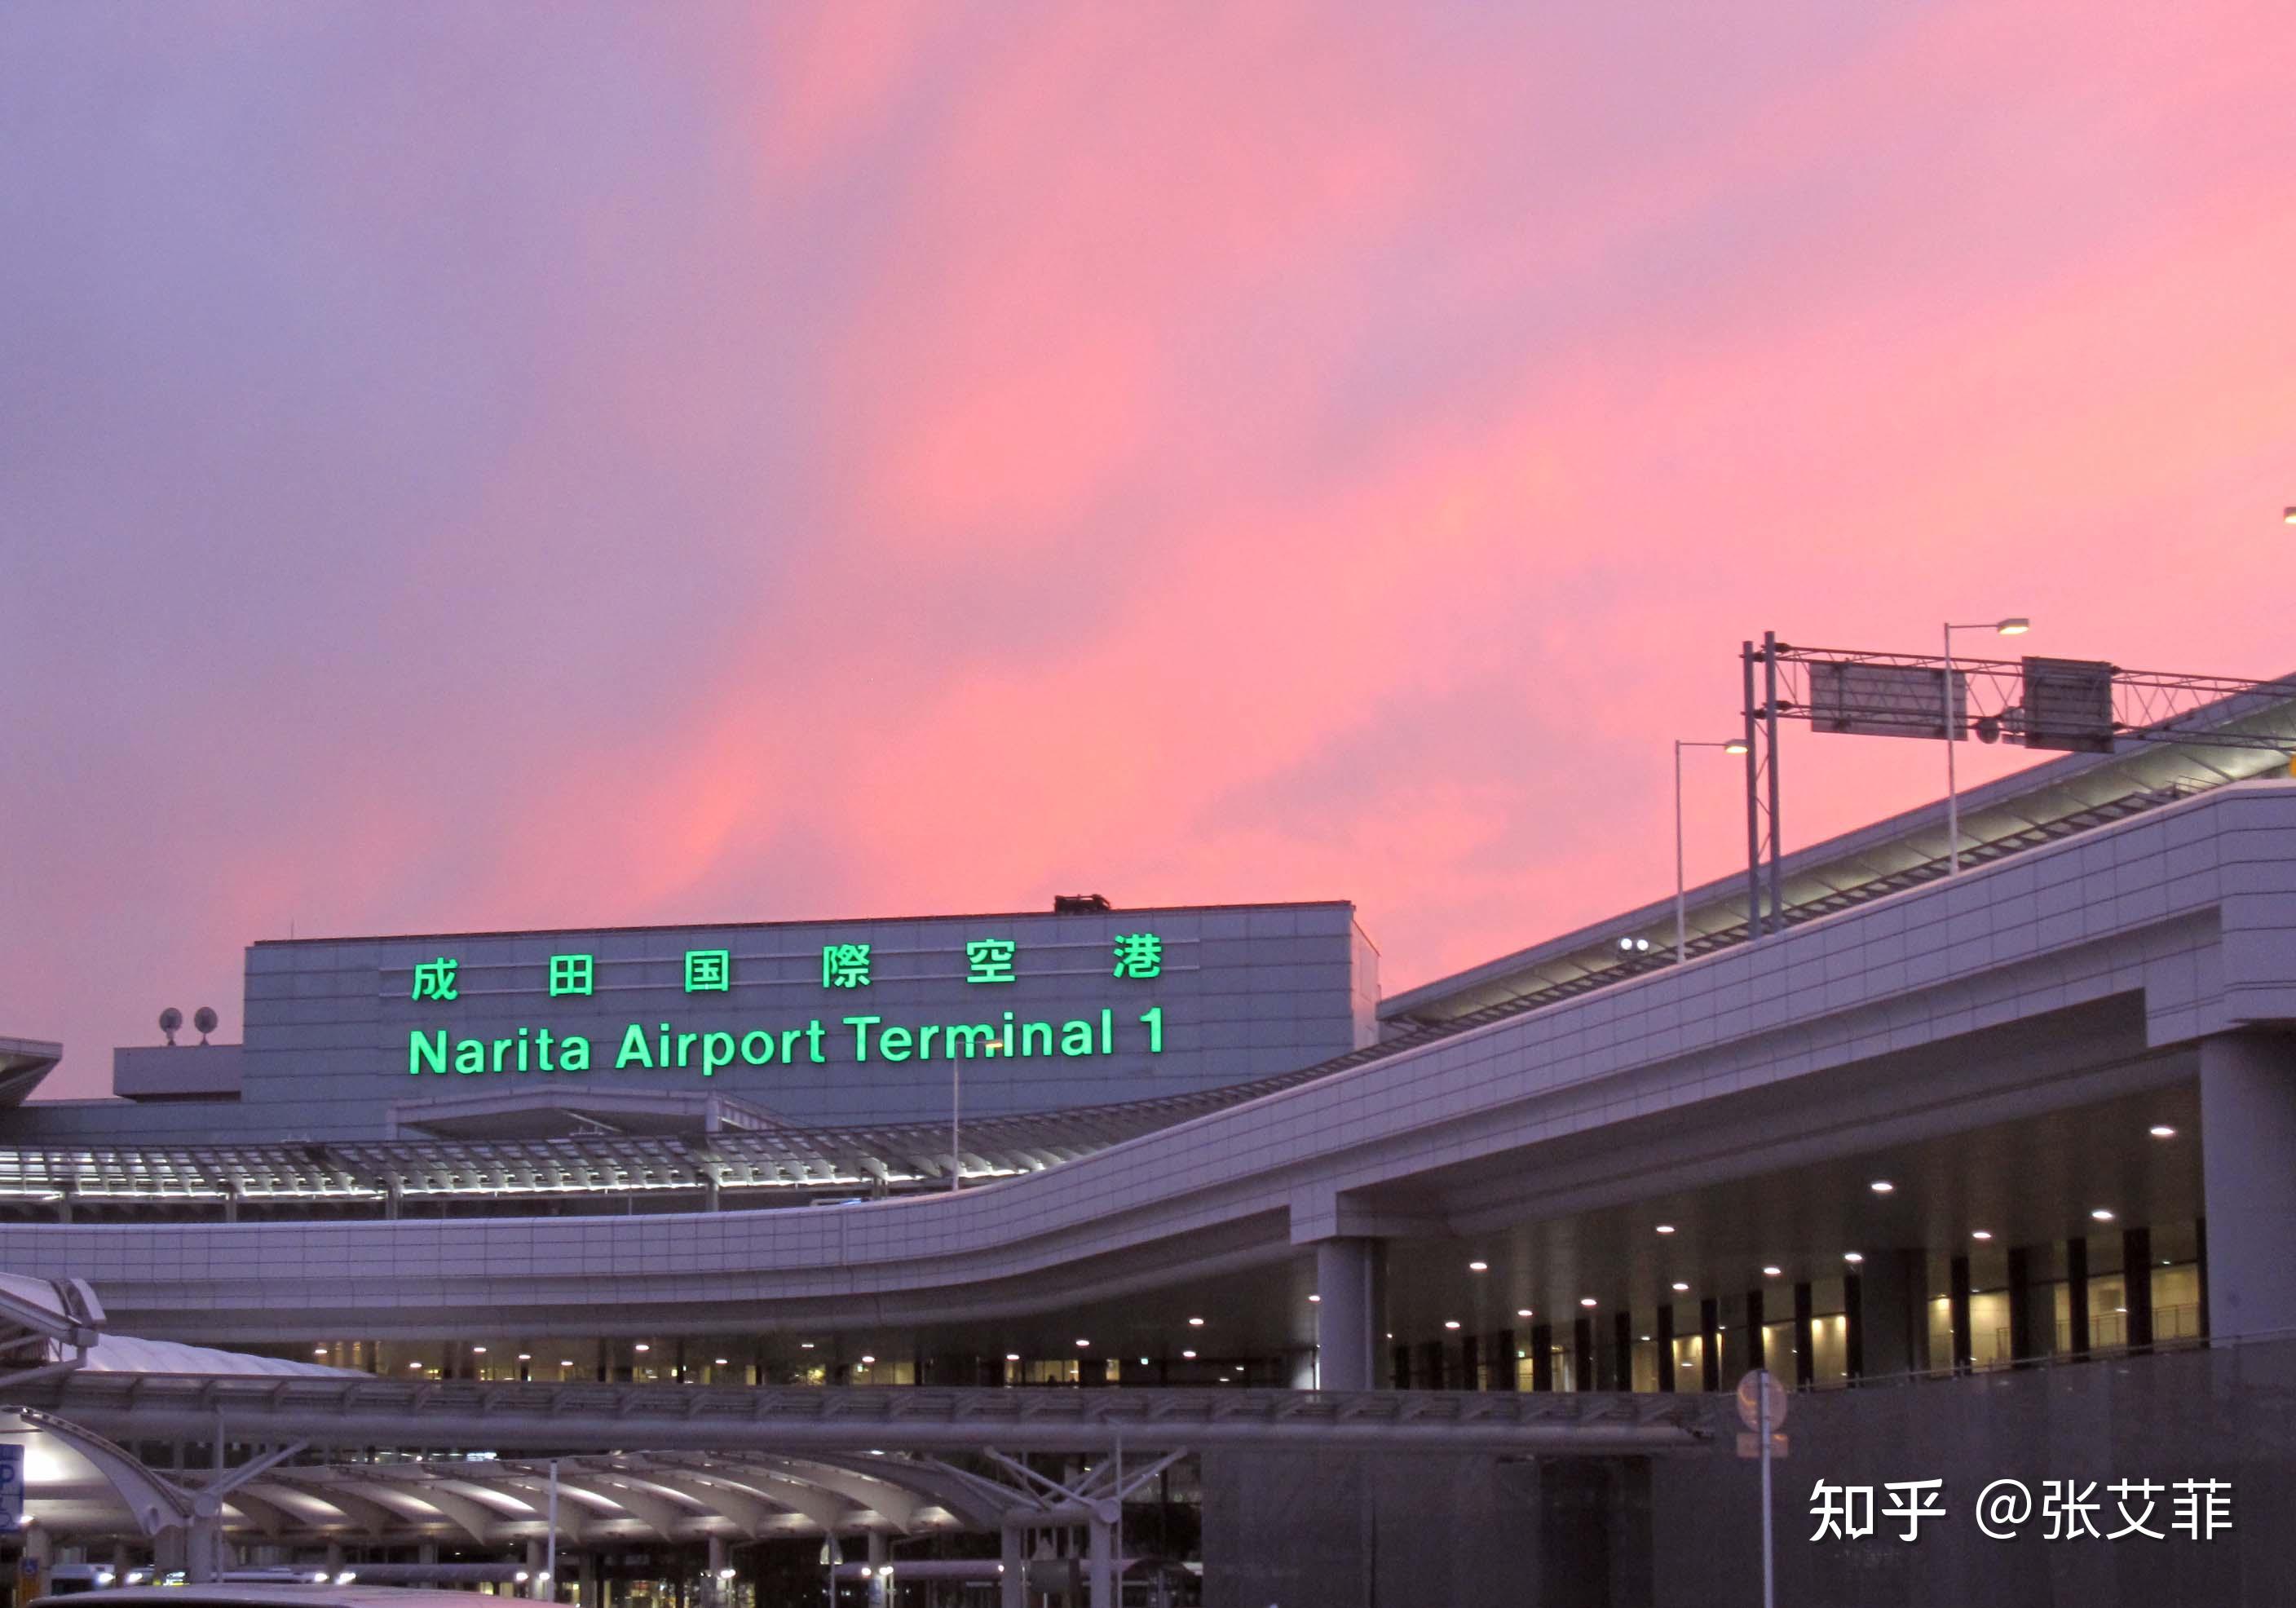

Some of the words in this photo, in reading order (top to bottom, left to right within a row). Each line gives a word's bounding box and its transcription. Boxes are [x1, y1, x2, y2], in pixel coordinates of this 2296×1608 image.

[411, 933, 1162, 1001] 成田国際空港
[408, 1026, 589, 1075] Narita
[616, 1023, 826, 1076] Airport
[843, 1008, 1112, 1062] Terminal
[1140, 1008, 1162, 1053] 1
